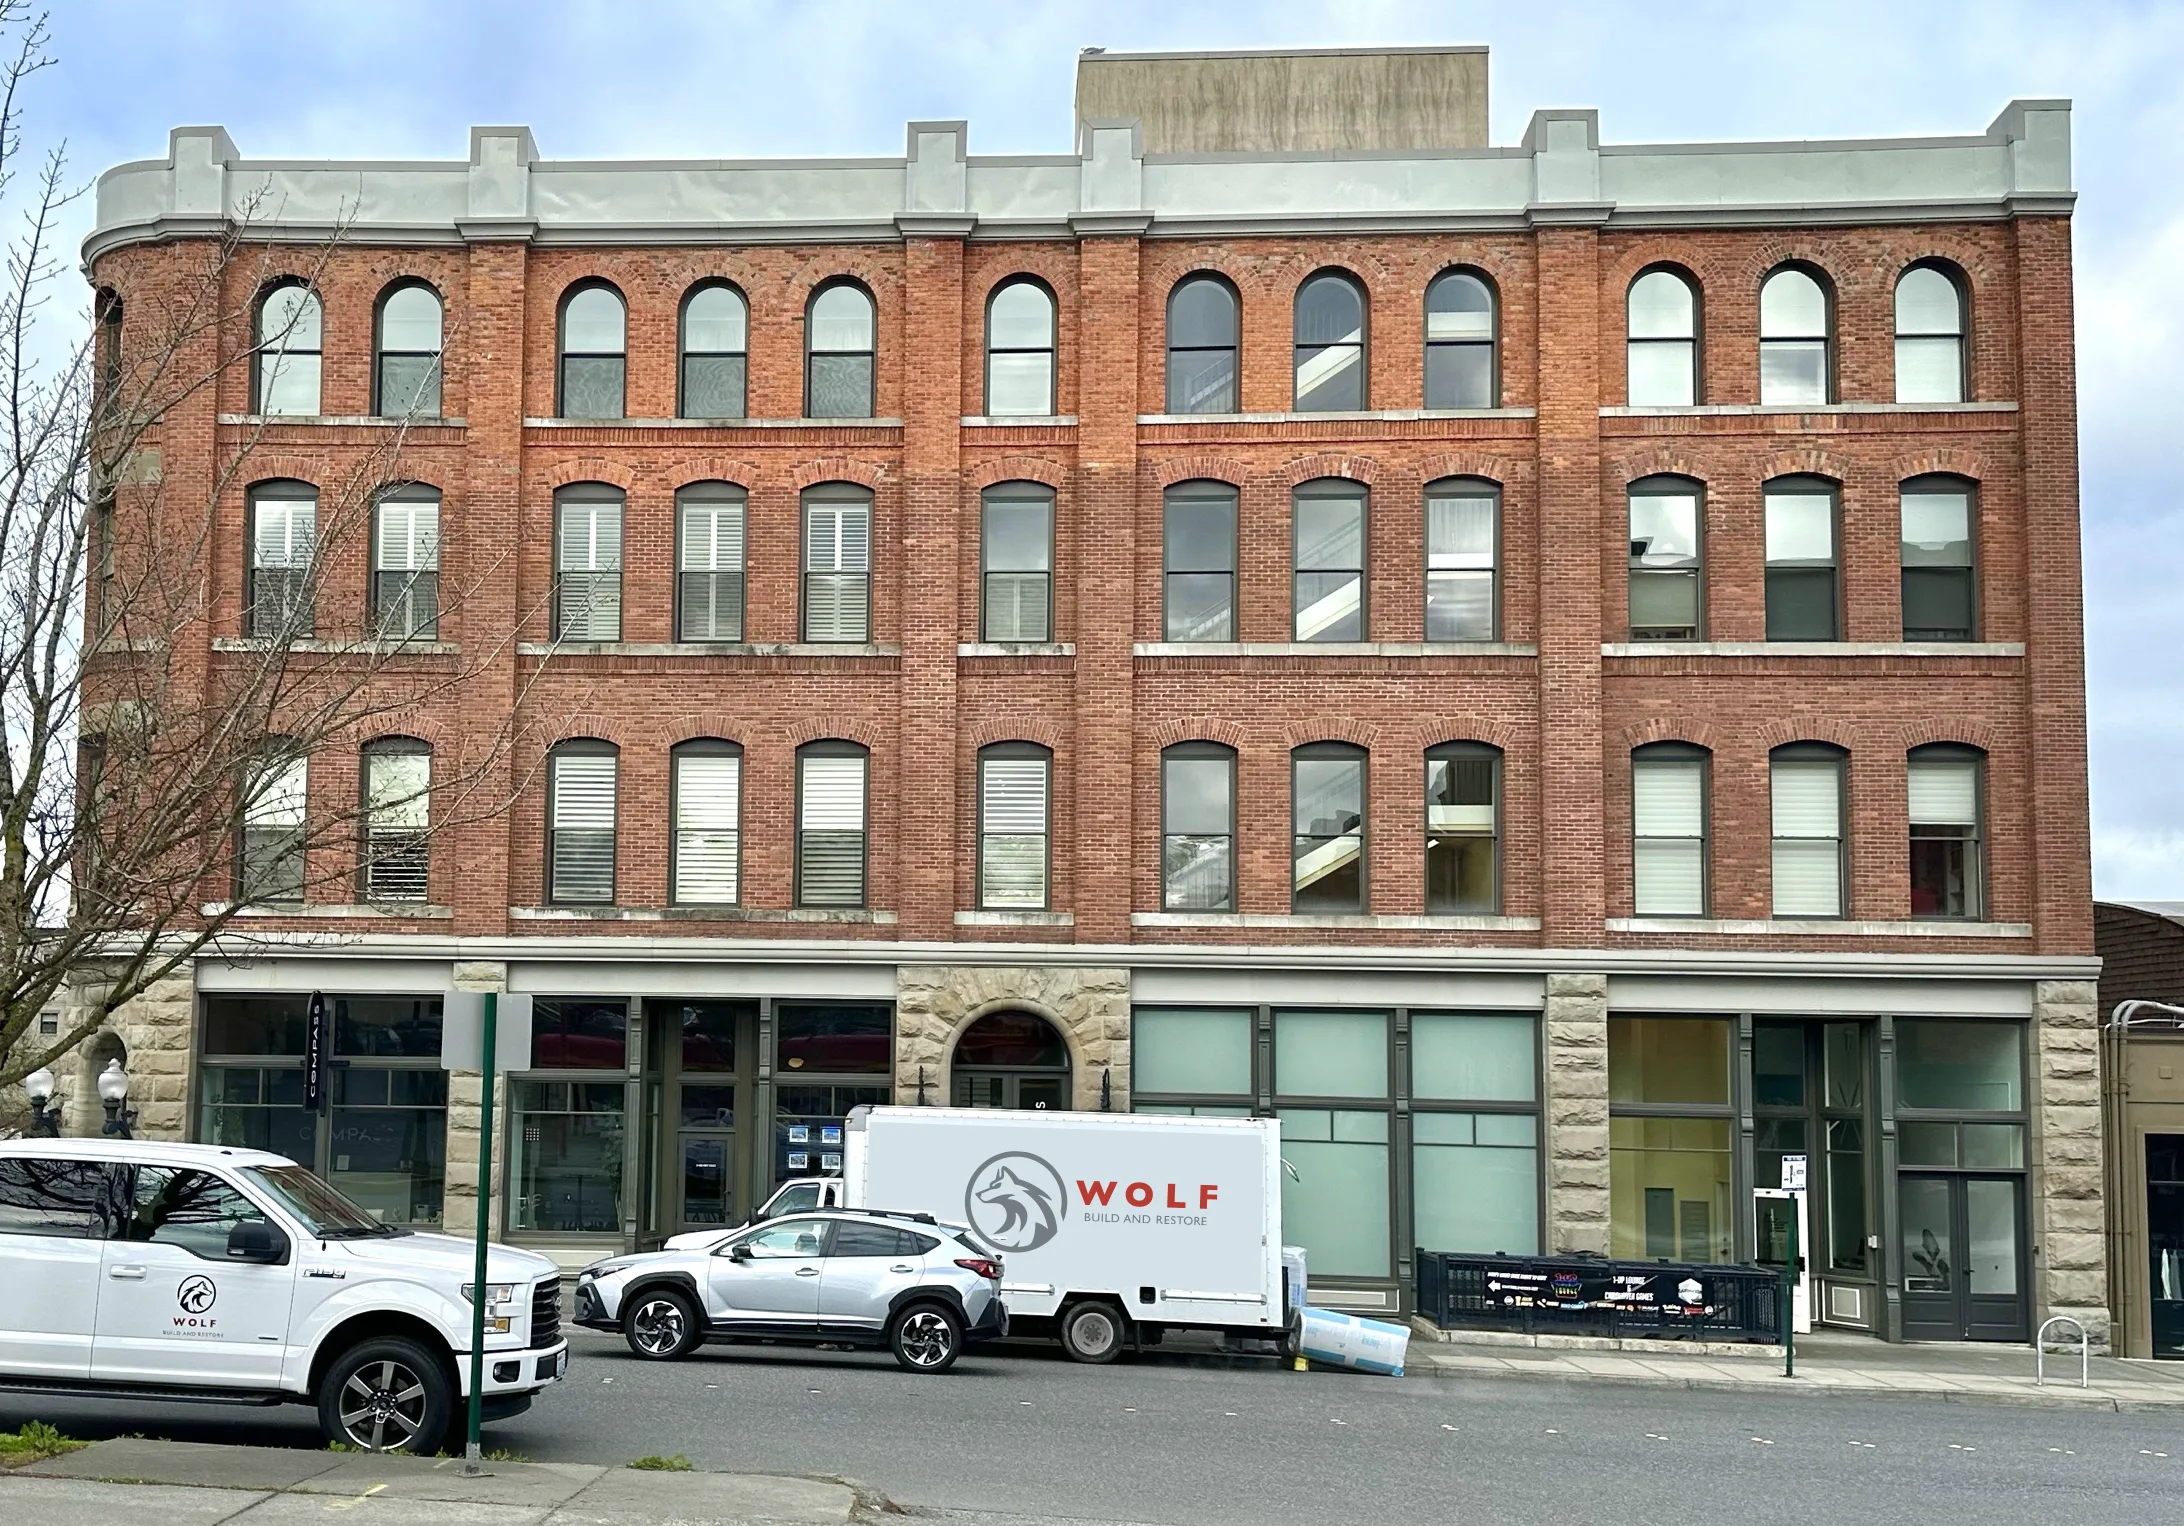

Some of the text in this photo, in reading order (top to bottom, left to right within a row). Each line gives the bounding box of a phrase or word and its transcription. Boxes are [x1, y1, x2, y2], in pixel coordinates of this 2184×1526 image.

[311, 1005, 320, 1098] COMPASS
[1076, 1180, 1218, 1209] WOLF
[1084, 1212, 1207, 1226] BUILD AND RESTORE
[173, 1317, 217, 1328] WOLF
